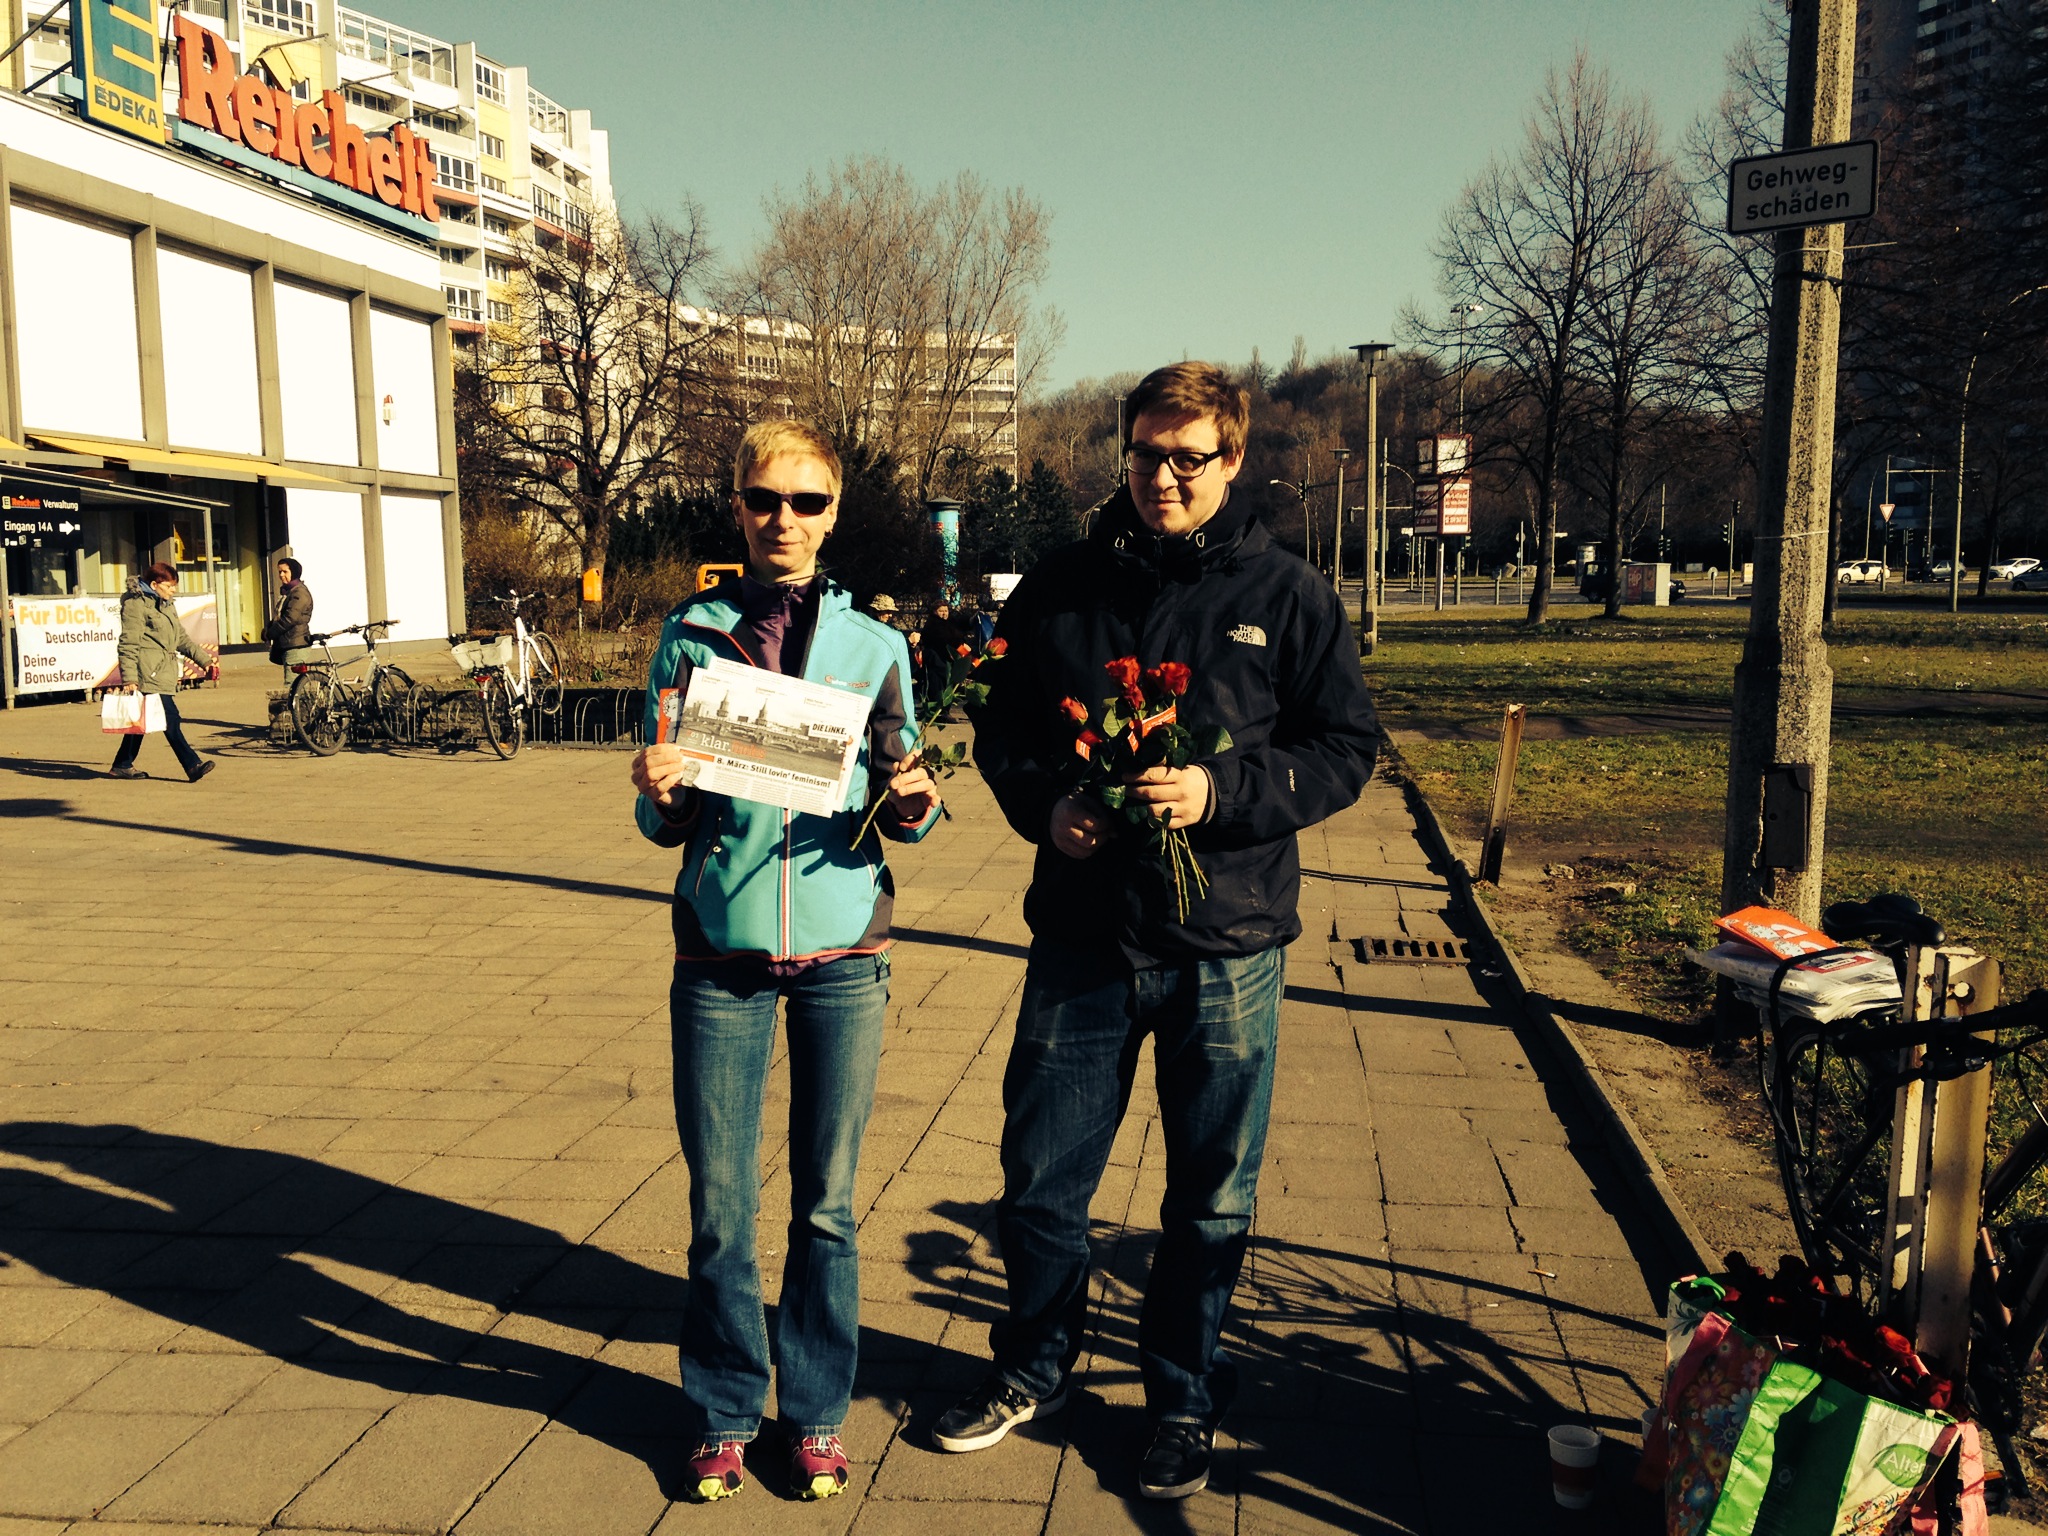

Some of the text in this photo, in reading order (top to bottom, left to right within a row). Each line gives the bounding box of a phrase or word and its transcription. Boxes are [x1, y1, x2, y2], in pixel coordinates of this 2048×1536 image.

[94, 85, 159, 129] EDEKA
[174, 14, 439, 222] Reichelt
[1747, 162, 1858, 191] Gehweg-
[1745, 190, 1850, 220] schäden
[43, 499, 78, 511] Verwaltung
[4, 520, 53, 534] Eingang 14A
[20, 604, 50, 626] Für
[55, 604, 100, 627] Dich,
[1226, 630, 1253, 638] NORTH
[1238, 623, 1254, 632] THE
[45, 628, 117, 644] Deutschland.
[1233, 635, 1253, 644] FACE
[23, 654, 57, 668] Deine
[25, 669, 94, 685] Bonuskarte.
[812, 723, 824, 732] DIE
[716, 757, 724, 765] 8.
[726, 759, 749, 770] März:
[750, 764, 767, 775] Still
[791, 773, 831, 788] feminism!
